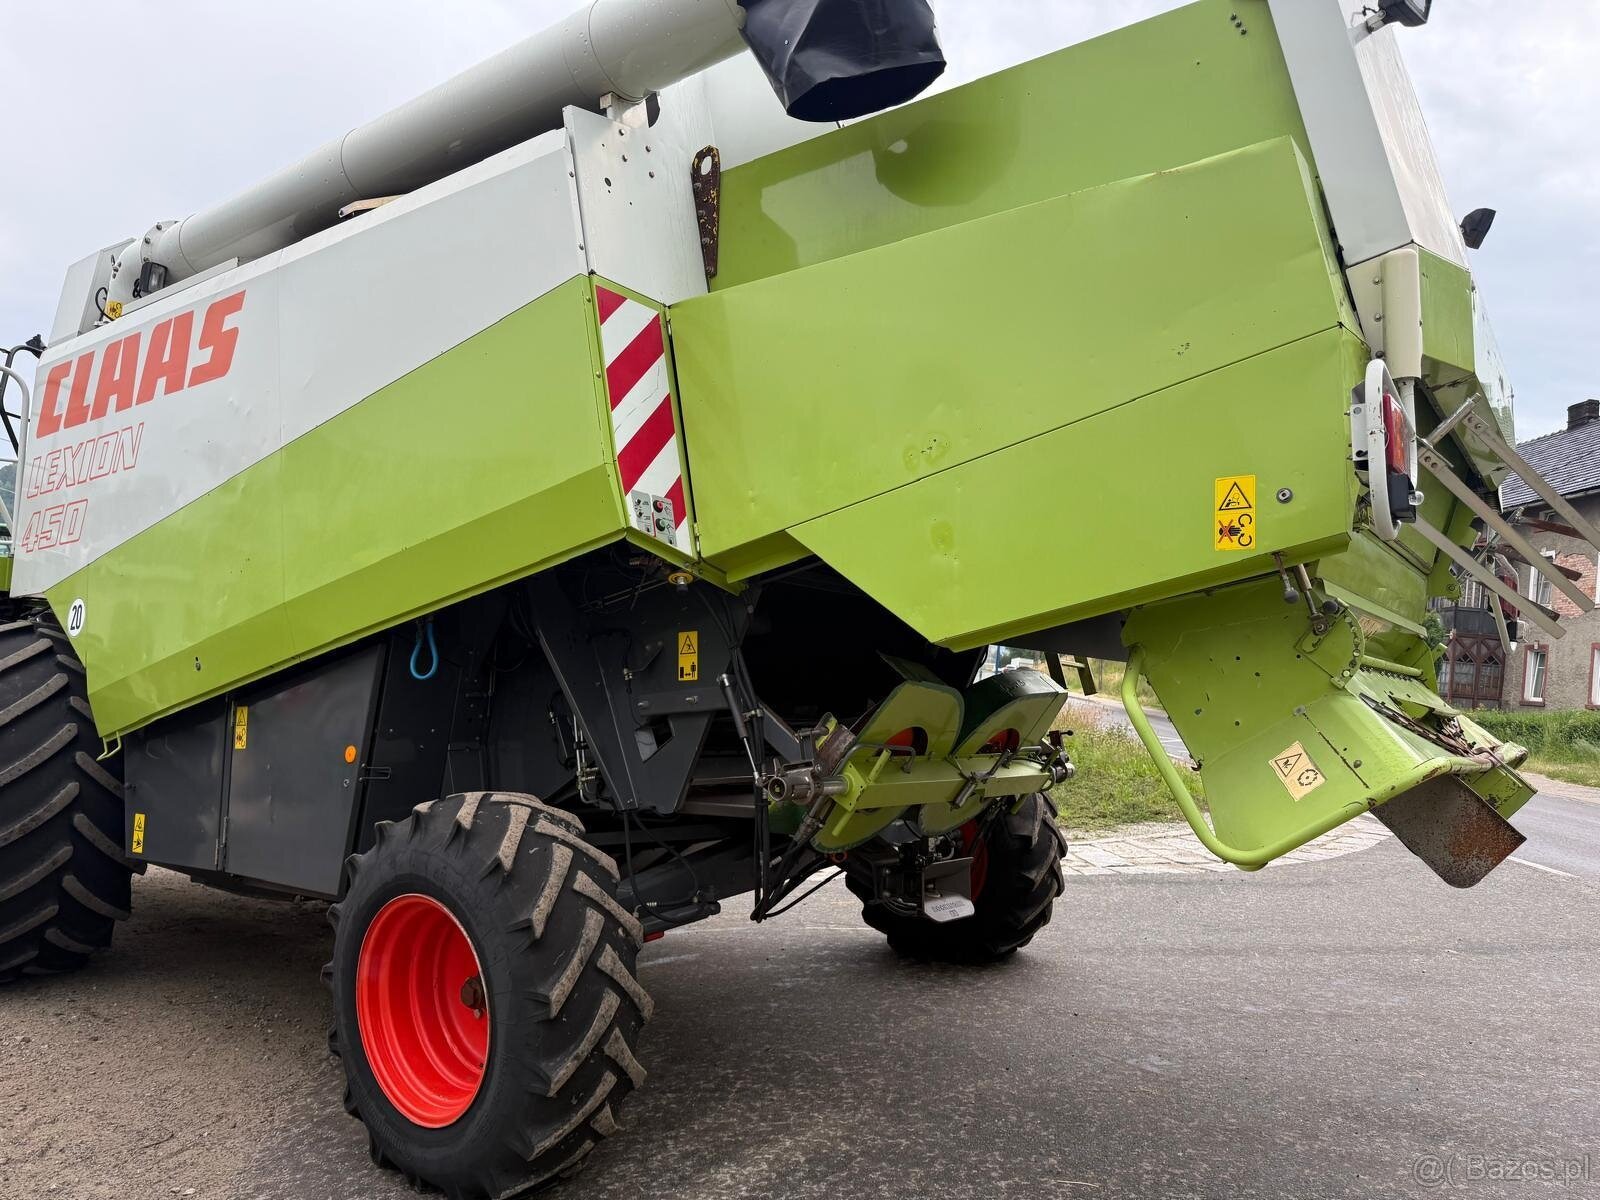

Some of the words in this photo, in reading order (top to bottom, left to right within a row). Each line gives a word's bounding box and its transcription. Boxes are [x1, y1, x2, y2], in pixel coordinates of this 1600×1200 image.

[36, 289, 247, 439] CLAAS
[27, 422, 144, 499] LEXION
[21, 498, 89, 553] 450
[69, 604, 83, 631] 20
